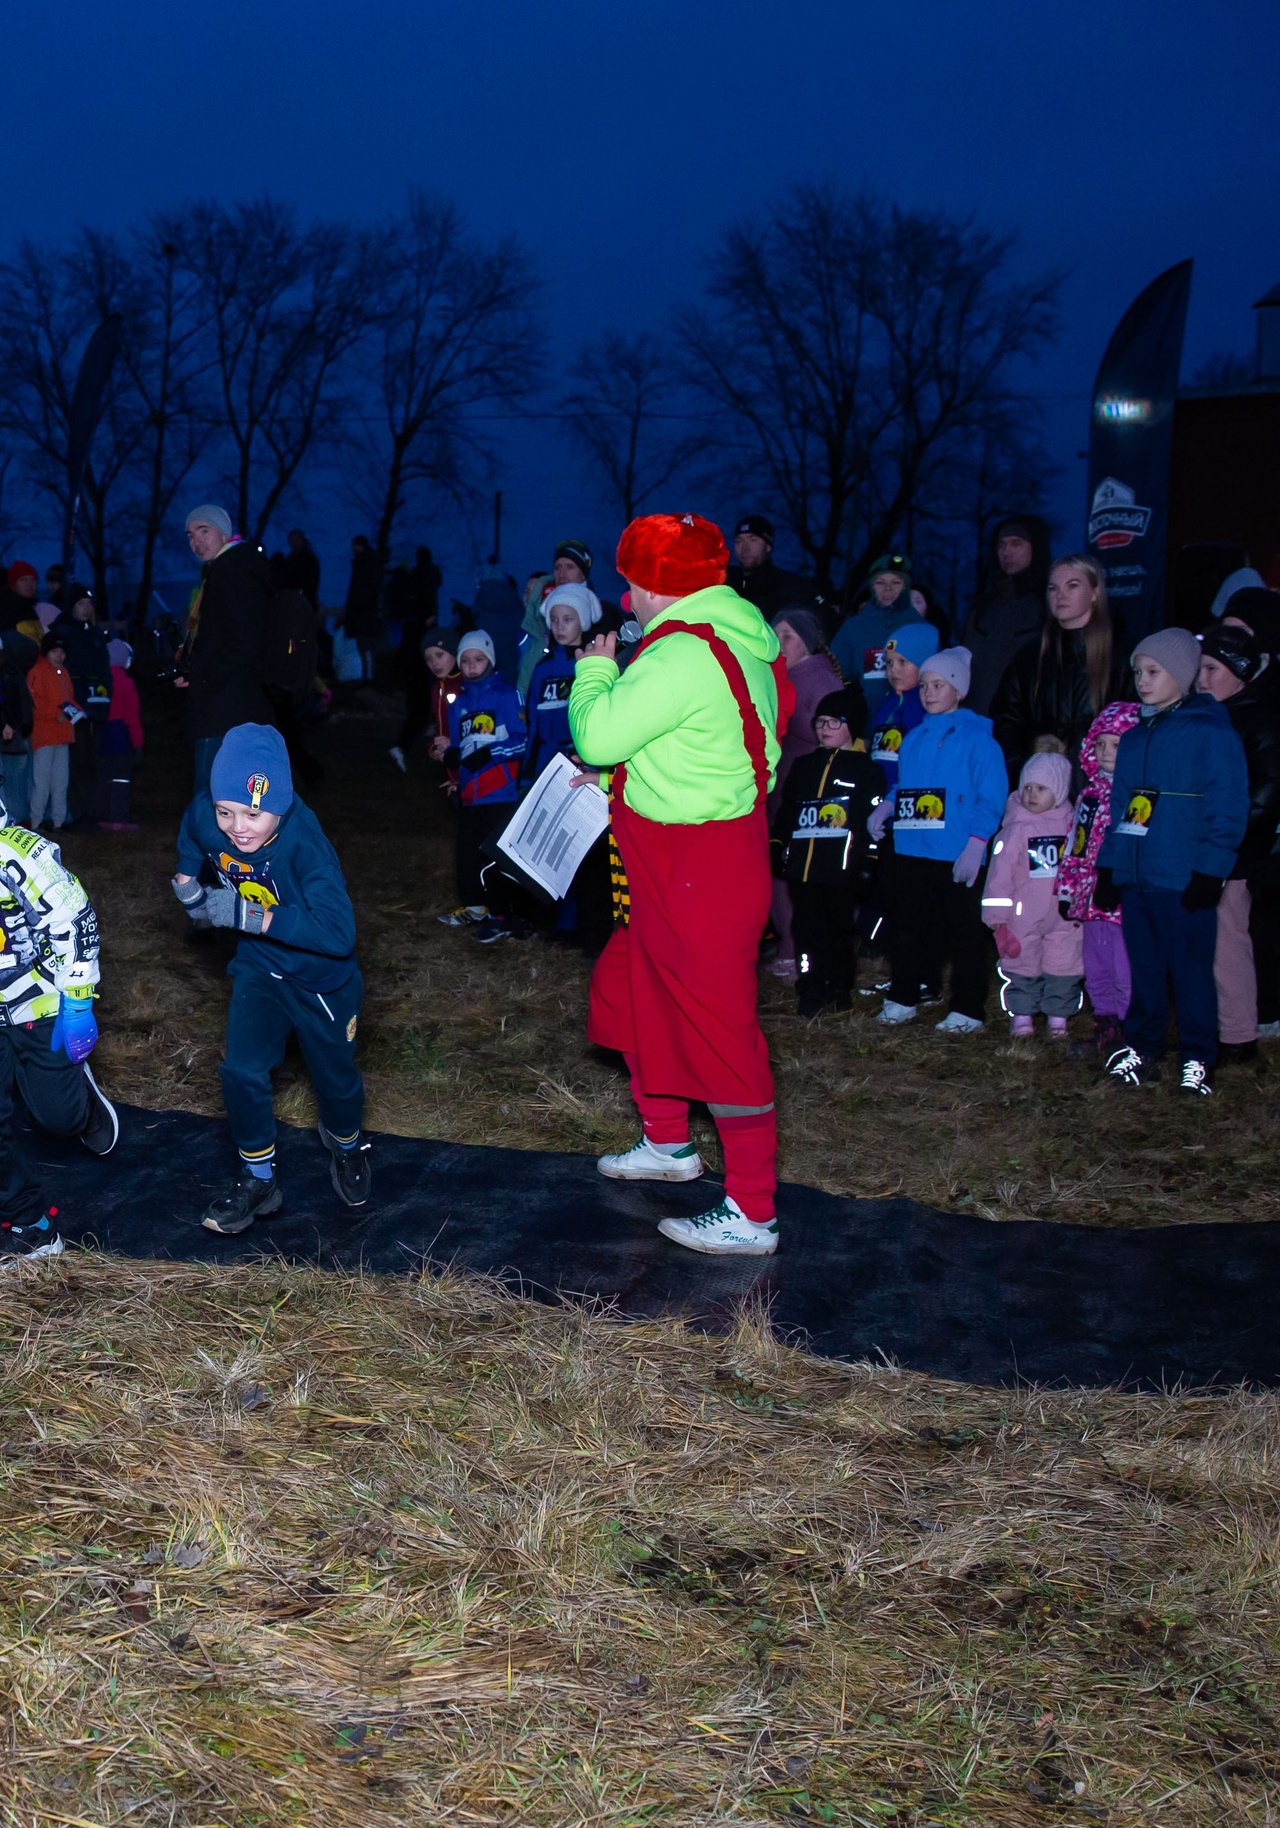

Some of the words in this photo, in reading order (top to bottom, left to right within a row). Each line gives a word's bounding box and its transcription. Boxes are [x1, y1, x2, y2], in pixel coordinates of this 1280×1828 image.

[874, 653, 887, 670] 3
[543, 683, 558, 700] 41
[461, 719, 472, 737] 39
[798, 806, 817, 827] 60
[898, 797, 915, 818] 33
